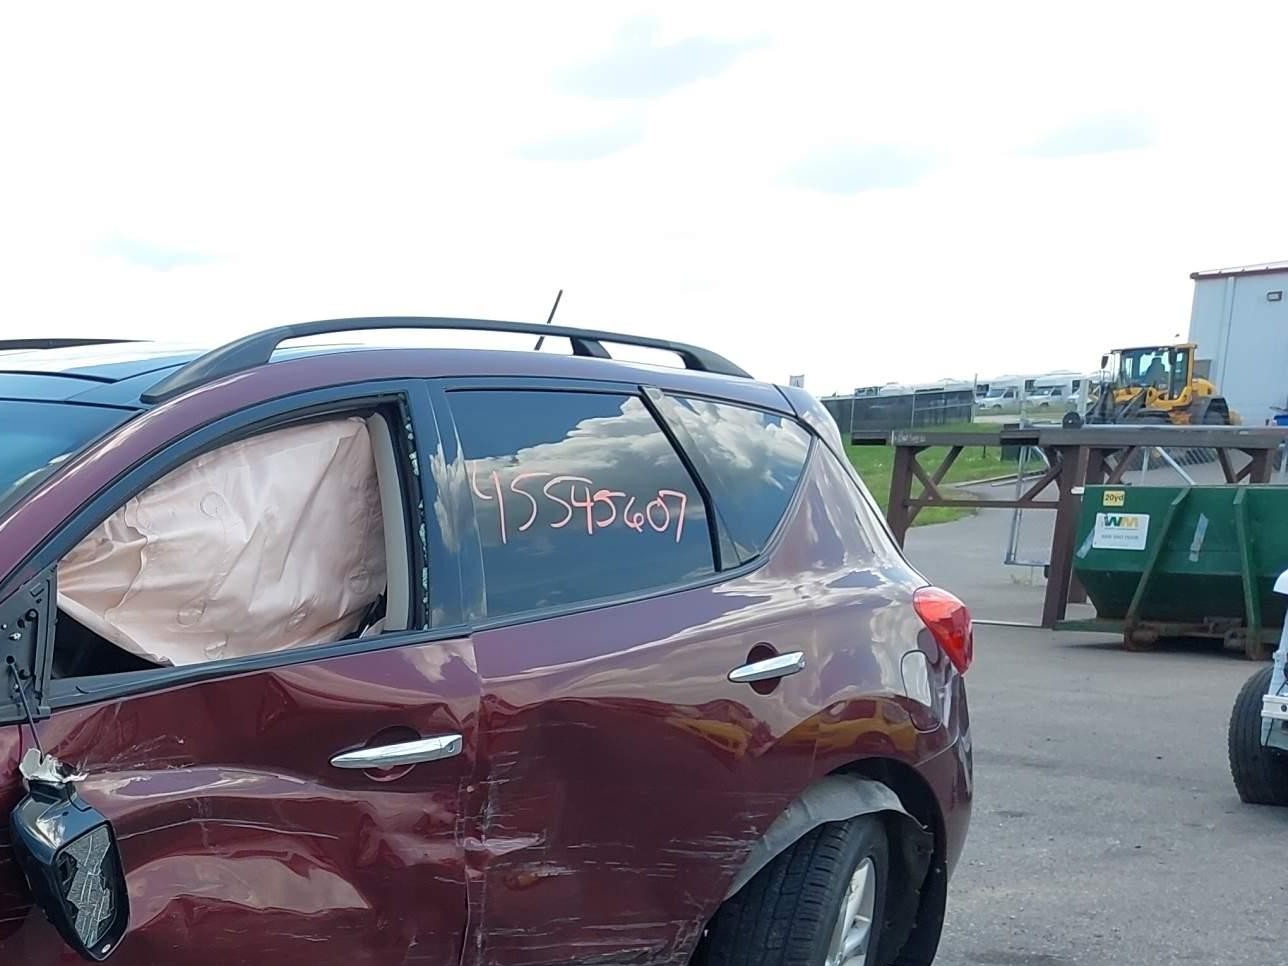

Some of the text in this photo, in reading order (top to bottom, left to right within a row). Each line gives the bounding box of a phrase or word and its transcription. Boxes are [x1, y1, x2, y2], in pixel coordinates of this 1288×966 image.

[472, 460, 687, 544] 45545607
[1105, 493, 1124, 502] 20yd
[1104, 516, 1139, 528] WM
